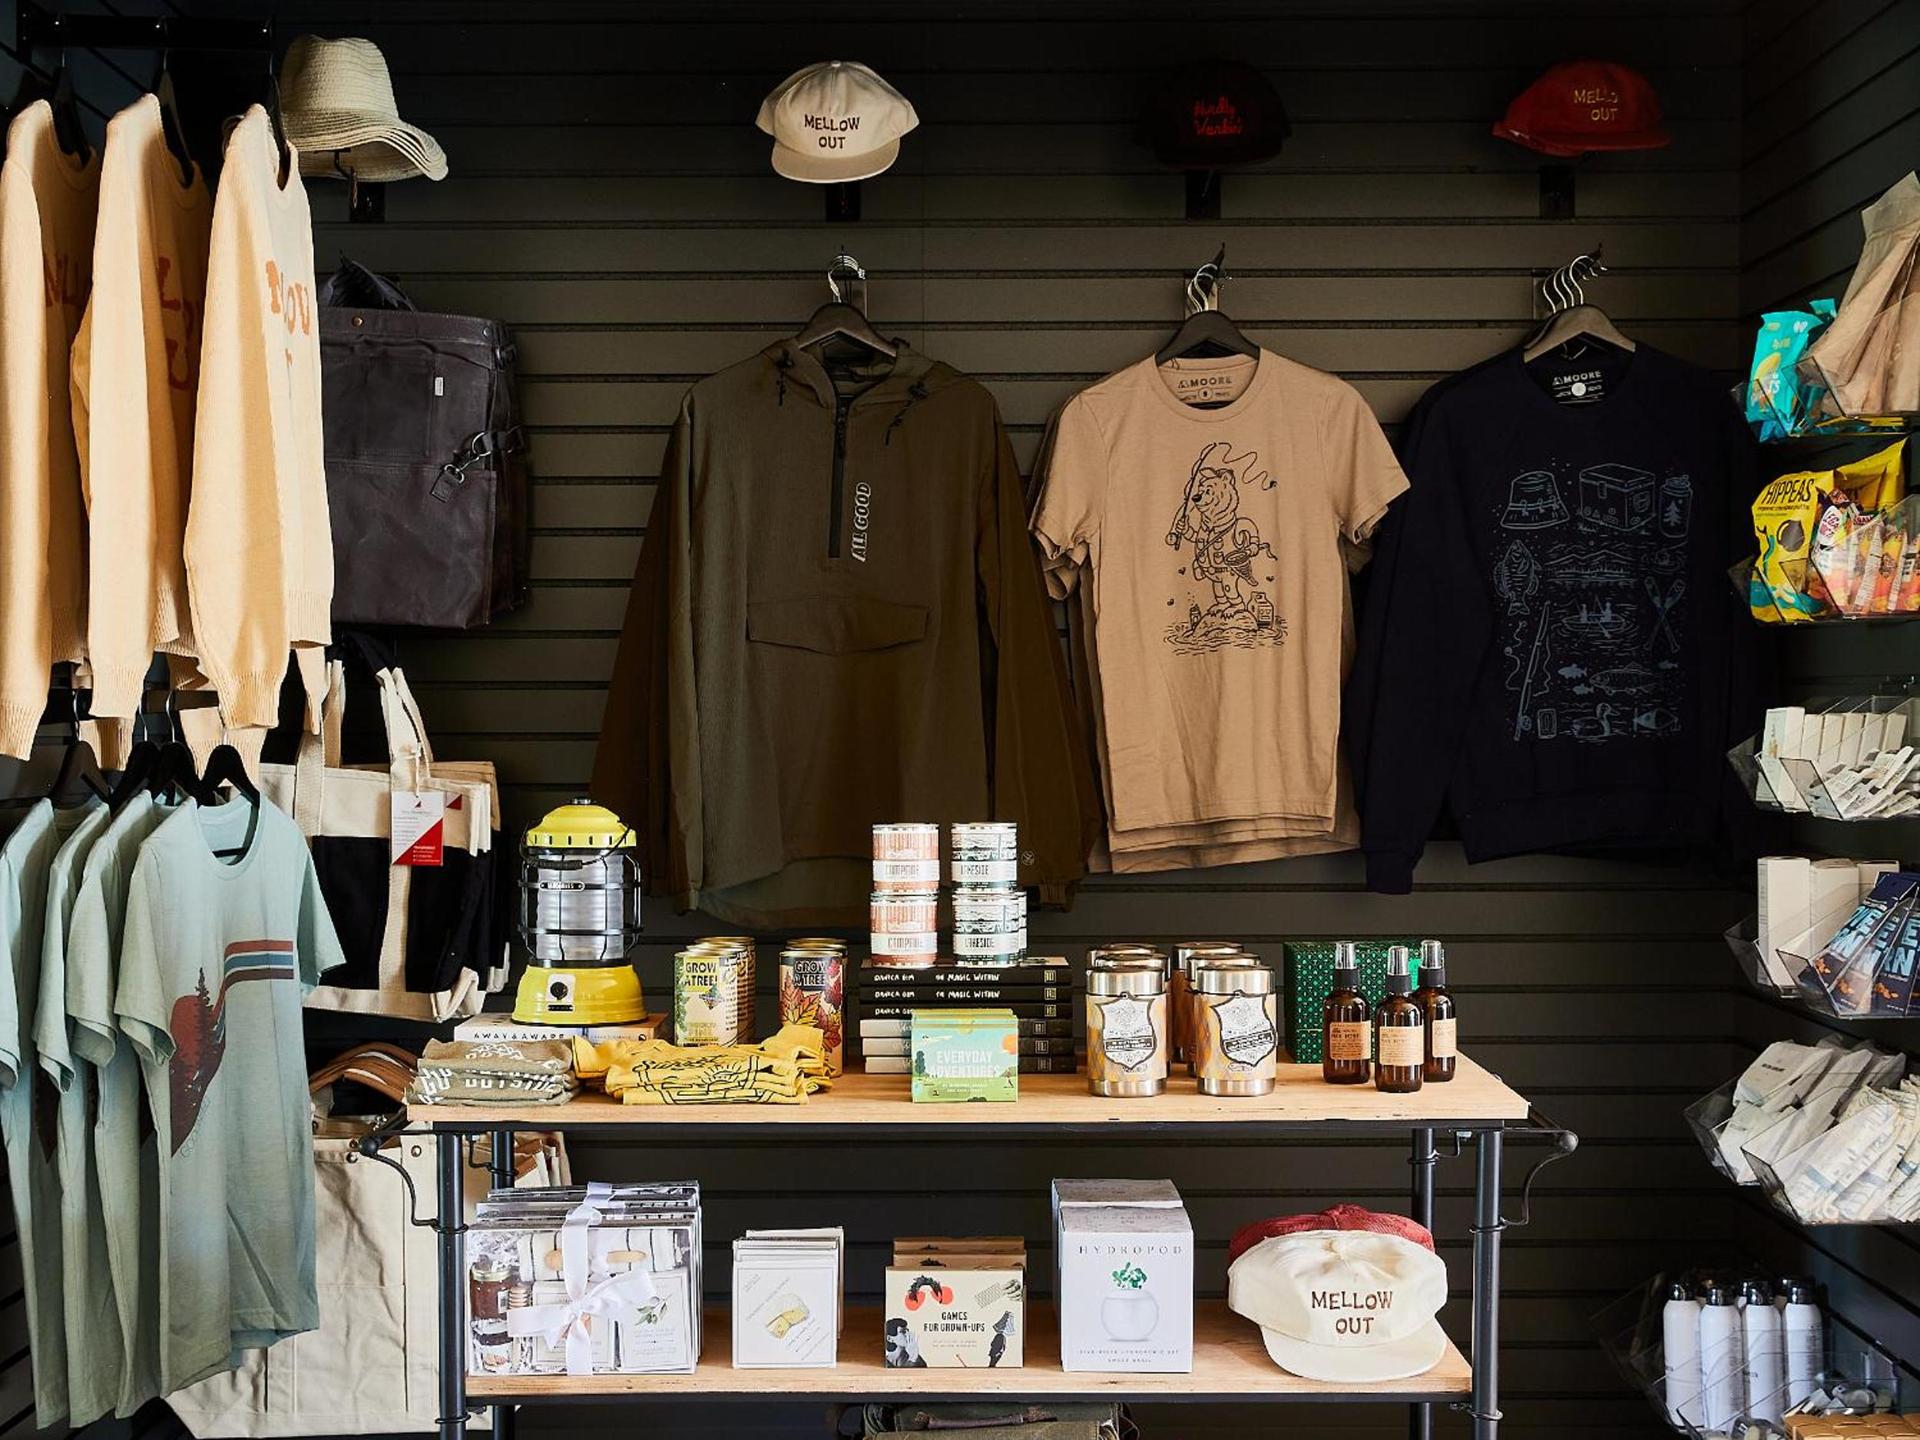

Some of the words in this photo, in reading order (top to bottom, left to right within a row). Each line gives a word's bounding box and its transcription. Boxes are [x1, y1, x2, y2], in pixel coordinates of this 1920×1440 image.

[1590, 107, 1619, 121] OUT
[804, 114, 860, 132] MELLOW
[818, 136, 846, 149] OUT
[1762, 478, 1815, 504] HIPPEAS
[854, 481, 872, 530] GOOD
[852, 532, 868, 563] ALL
[685, 962, 717, 974] GROW
[937, 1050, 992, 1063] EVERYDAY
[1079, 1246, 1183, 1255] HYDROPOD
[1311, 1290, 1393, 1310] MELLOW
[941, 1310, 968, 1321] GAMES
[940, 1322, 986, 1333] GROWN-UPS
[1335, 1316, 1375, 1335] OUT
